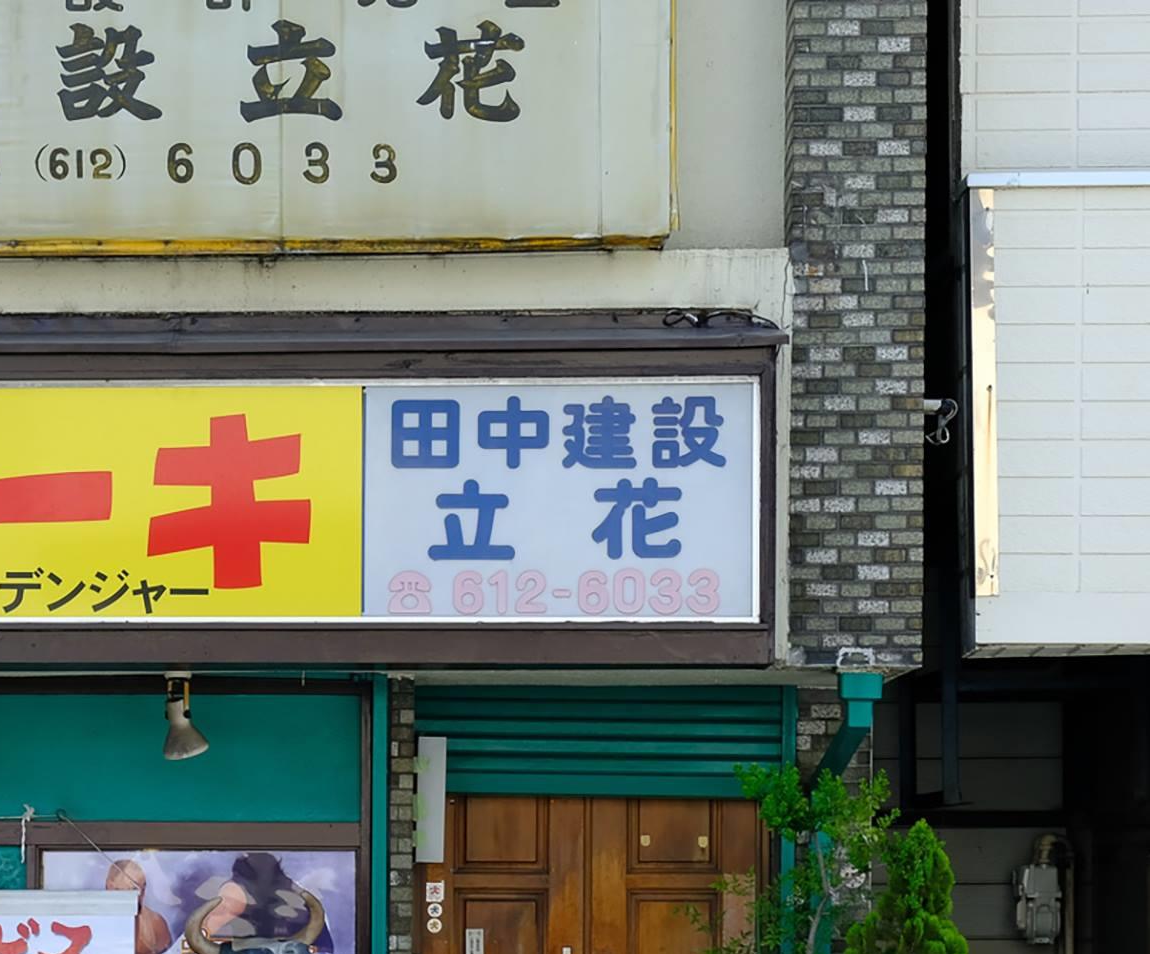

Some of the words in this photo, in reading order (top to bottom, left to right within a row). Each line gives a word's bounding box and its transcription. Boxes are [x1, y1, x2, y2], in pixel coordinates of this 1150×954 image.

[391, 396, 727, 469] 田中建設
[428, 477, 683, 561] 立花
[452, 568, 722, 615] 612-6033
